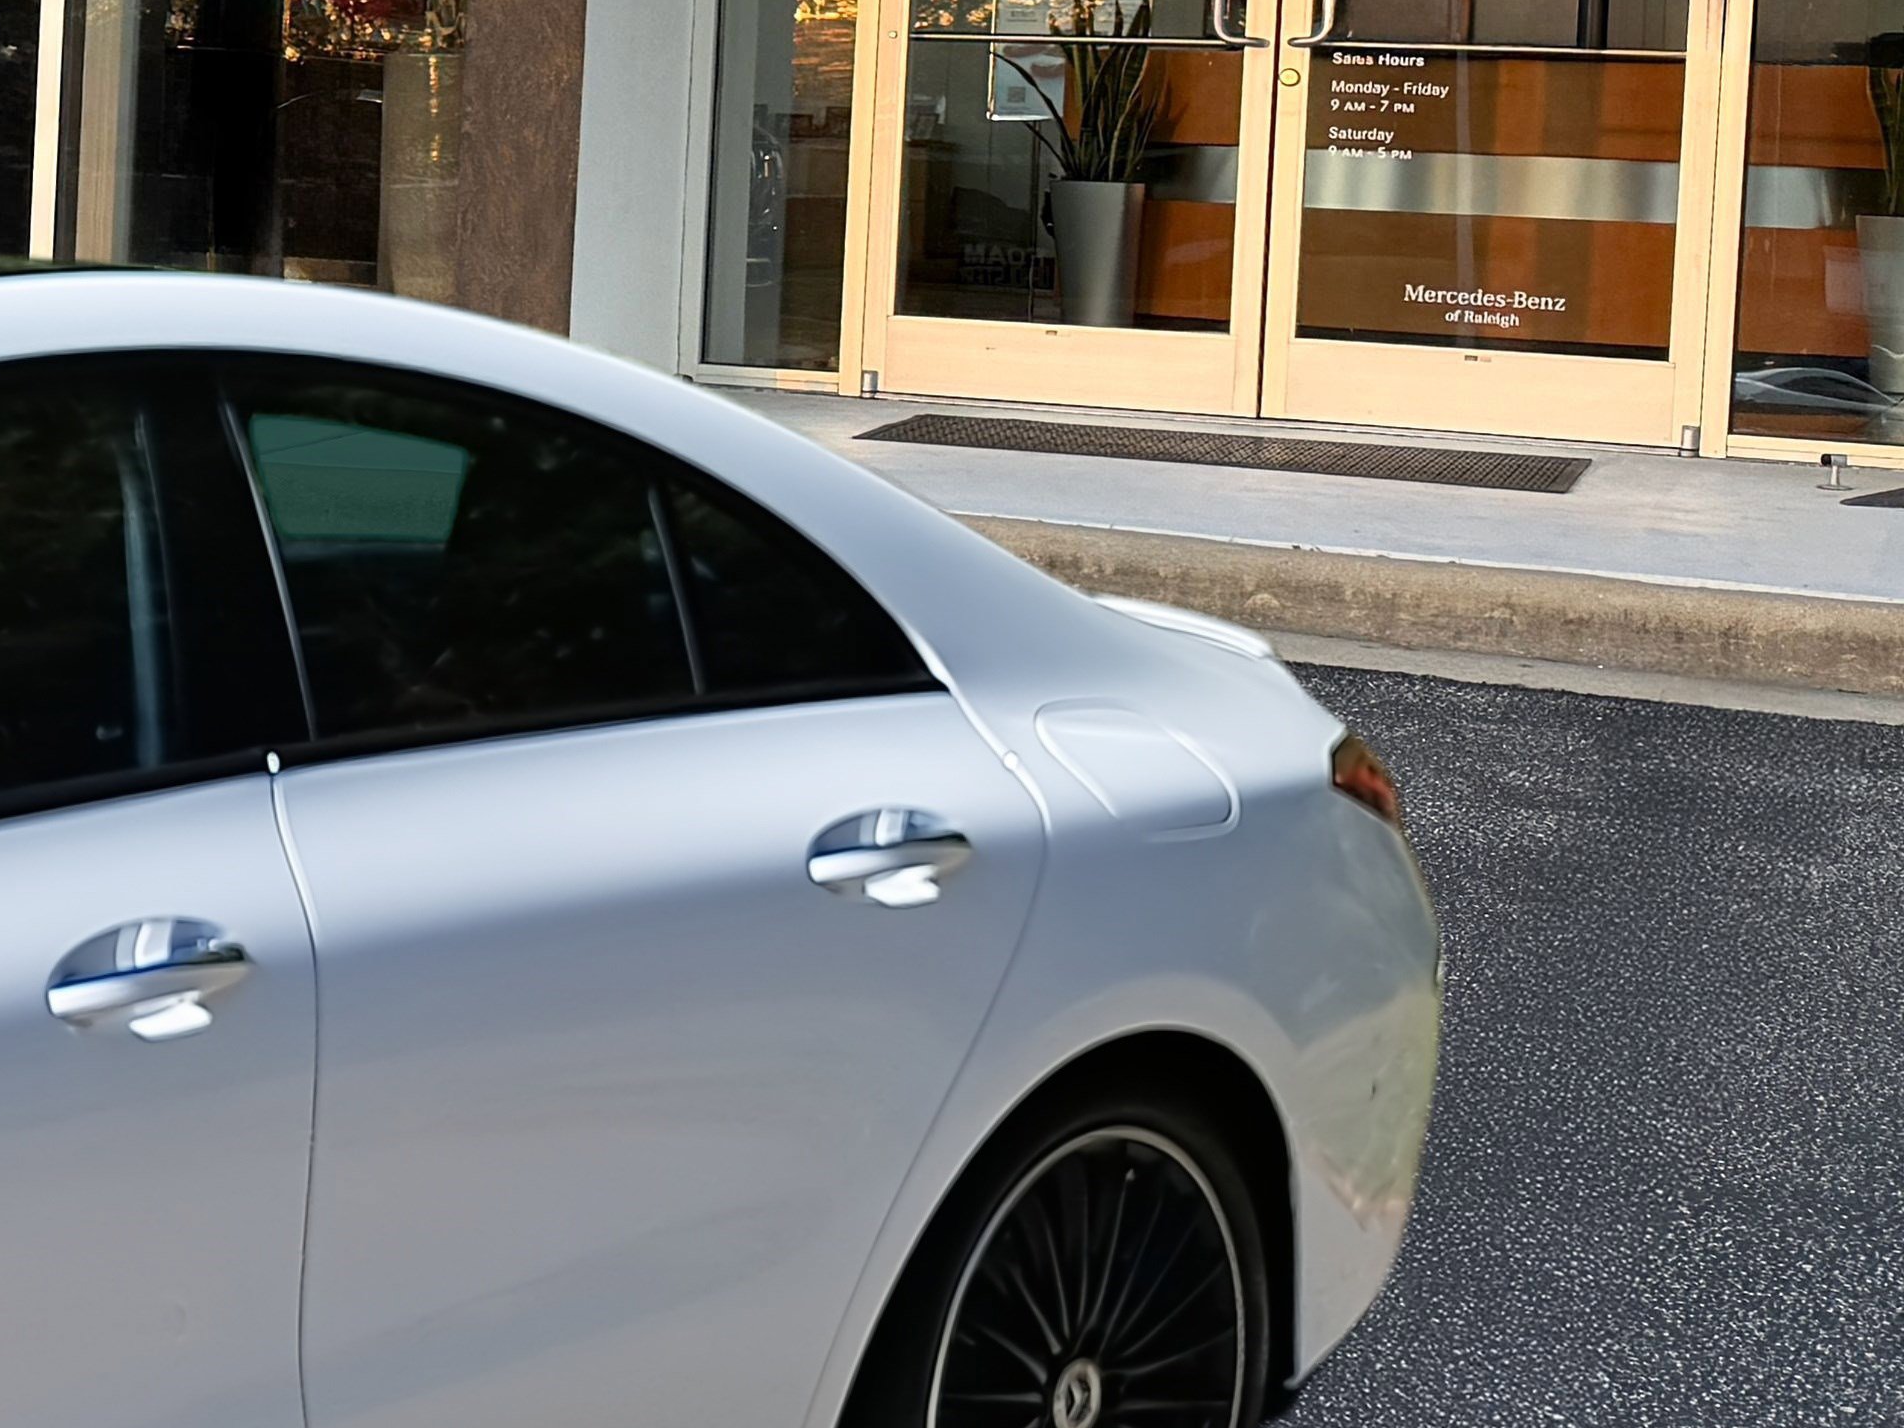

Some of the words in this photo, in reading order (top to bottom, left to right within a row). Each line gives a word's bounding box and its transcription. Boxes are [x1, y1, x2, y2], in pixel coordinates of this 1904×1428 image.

[1378, 54, 1425, 67] Hours
[1331, 80, 1390, 97] Monday
[1403, 82, 1449, 98] Friday
[1330, 99, 1340, 111] 9
[1344, 102, 1365, 111] AM
[1379, 100, 1389, 112] 7
[1393, 103, 1415, 113] PM
[1328, 126, 1394, 143] Saturday
[1328, 145, 1338, 157] 9
[1342, 148, 1363, 158] AM
[1378, 146, 1386, 158] 5
[1392, 149, 1412, 159] PM
[1403, 284, 1566, 311] Mercedes-Benz
[1445, 310, 1460, 322] of
[1464, 310, 1520, 328] Raleigh
